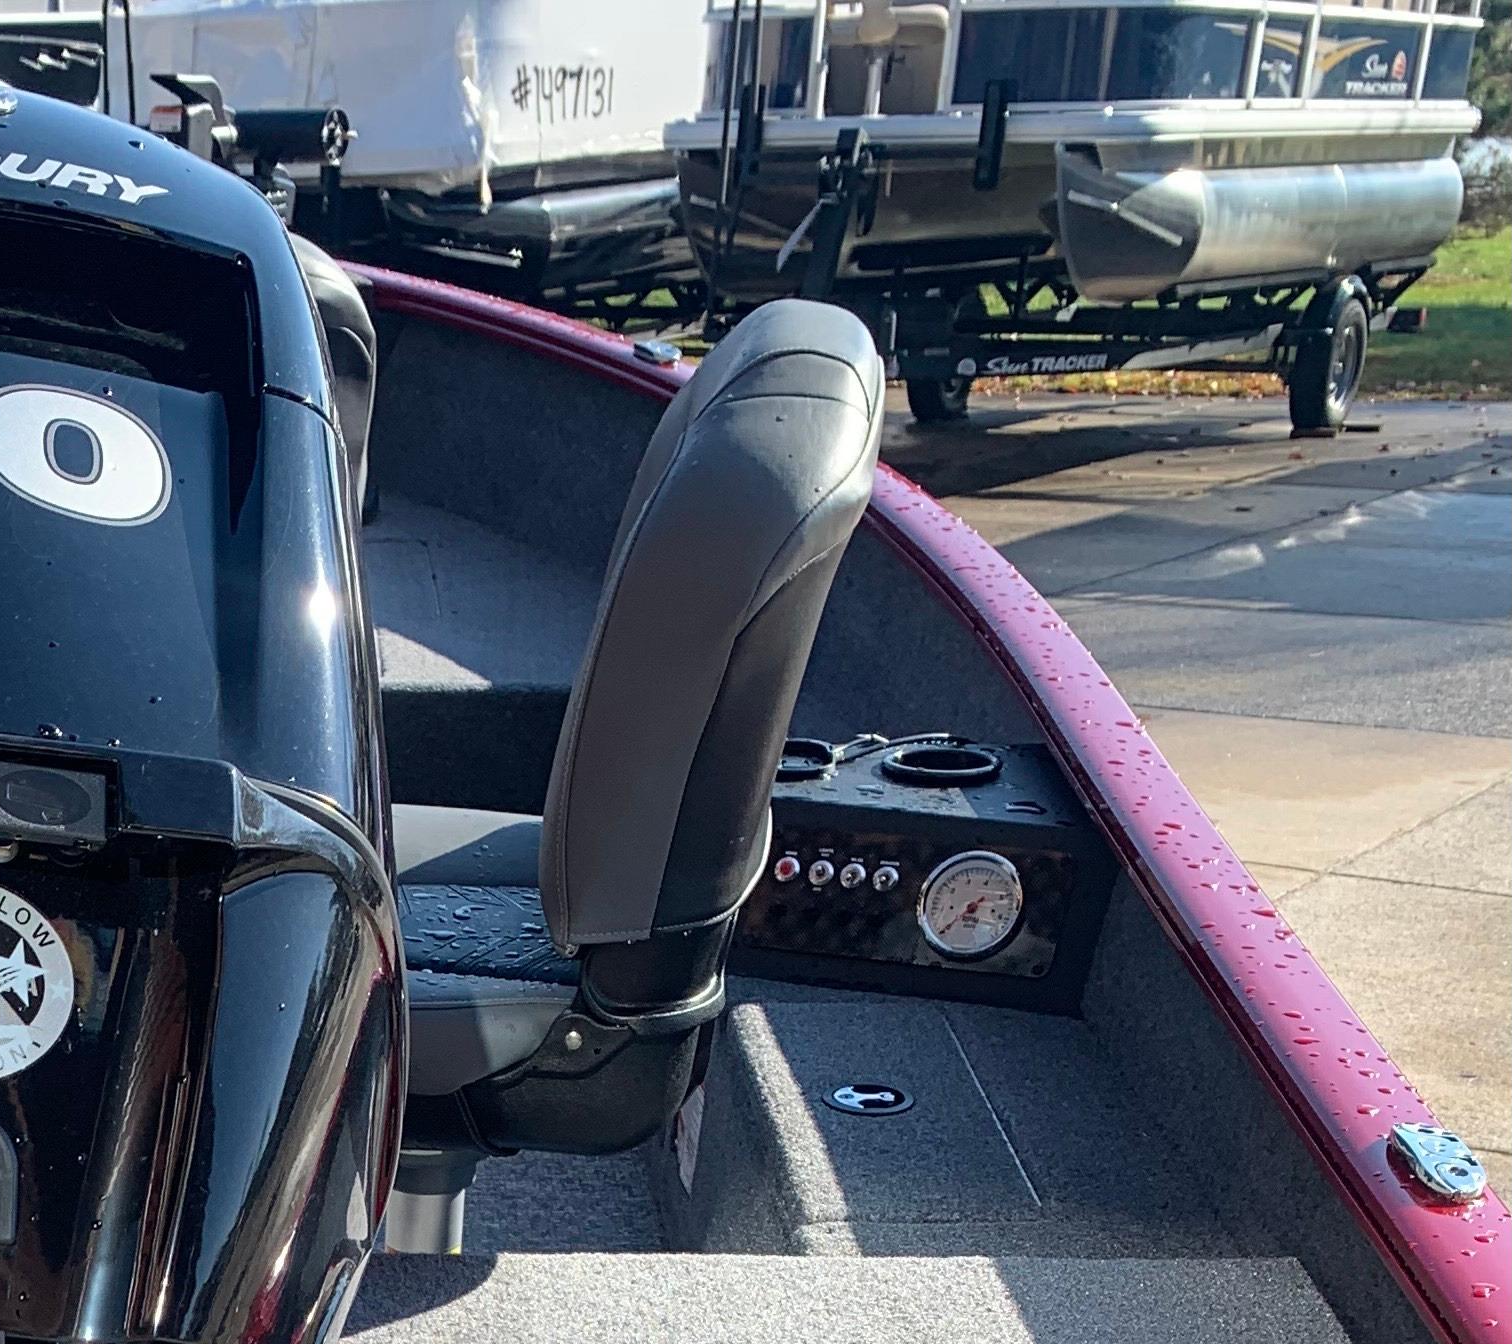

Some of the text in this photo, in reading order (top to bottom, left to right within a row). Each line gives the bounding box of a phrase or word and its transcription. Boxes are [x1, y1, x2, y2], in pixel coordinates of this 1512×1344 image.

[1345, 81, 1408, 95] TRACKER
[987, 353, 1108, 373] Sun TRACKER
